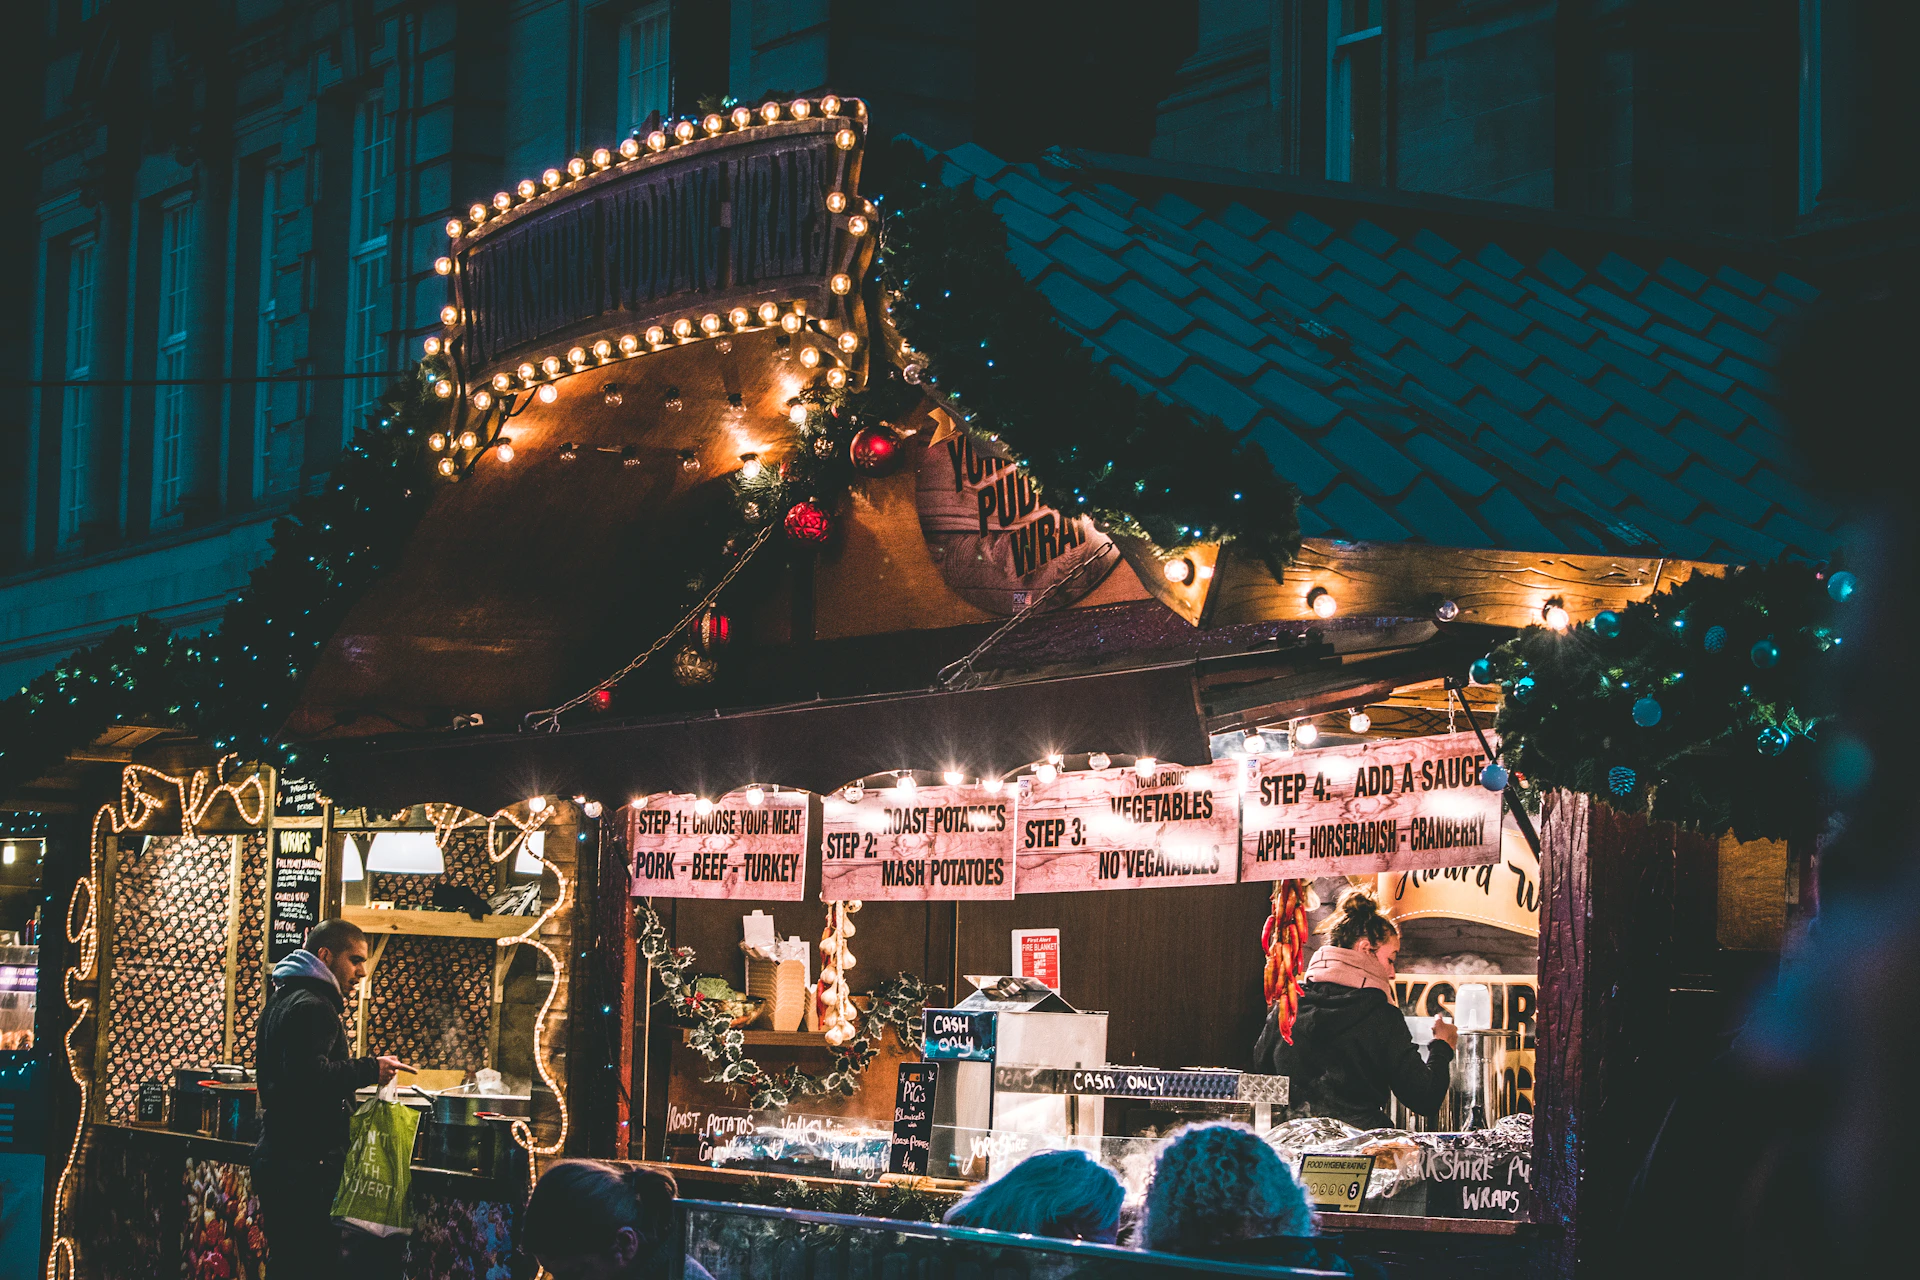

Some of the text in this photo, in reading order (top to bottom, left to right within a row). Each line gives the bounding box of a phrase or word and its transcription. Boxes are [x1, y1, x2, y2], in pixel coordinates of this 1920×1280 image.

[602, 166, 721, 312] PUDDING
[729, 149, 828, 287] WRAPS
[1260, 754, 1486, 807] STEP 4: ADD A SAUCE
[934, 804, 1006, 834] POTATOES
[1111, 790, 1213, 823] VEGETABLES
[639, 809, 802, 835] STEP 1: CHOOSE YOUR MEAT
[1025, 817, 1086, 848] STEP 3:
[280, 830, 312, 854] WRAPS
[827, 832, 878, 859] STEP 2:
[1256, 828, 1296, 863] APPLE
[1309, 819, 1397, 859] HORSERADISH
[1411, 812, 1486, 851] CRANBERRY
[636, 851, 676, 880] PORK
[692, 852, 728, 881] BEEF
[744, 853, 800, 882] TURKEY
[882, 858, 1004, 887] MASH POTATOES
[1099, 851, 1120, 880] NO
[1022, 943, 1057, 951] FIRE BLANKET
[933, 1015, 969, 1034] CASH
[1127, 1075, 1165, 1095] ONLY
[706, 1113, 754, 1138] POTATOS
[1307, 1161, 1367, 1170] FOOD HYGIENE RATING
[1382, 1150, 1495, 1198] YORKSHIRE
[1349, 1184, 1358, 1198] 5
[1463, 1186, 1520, 1213] WRAPS
